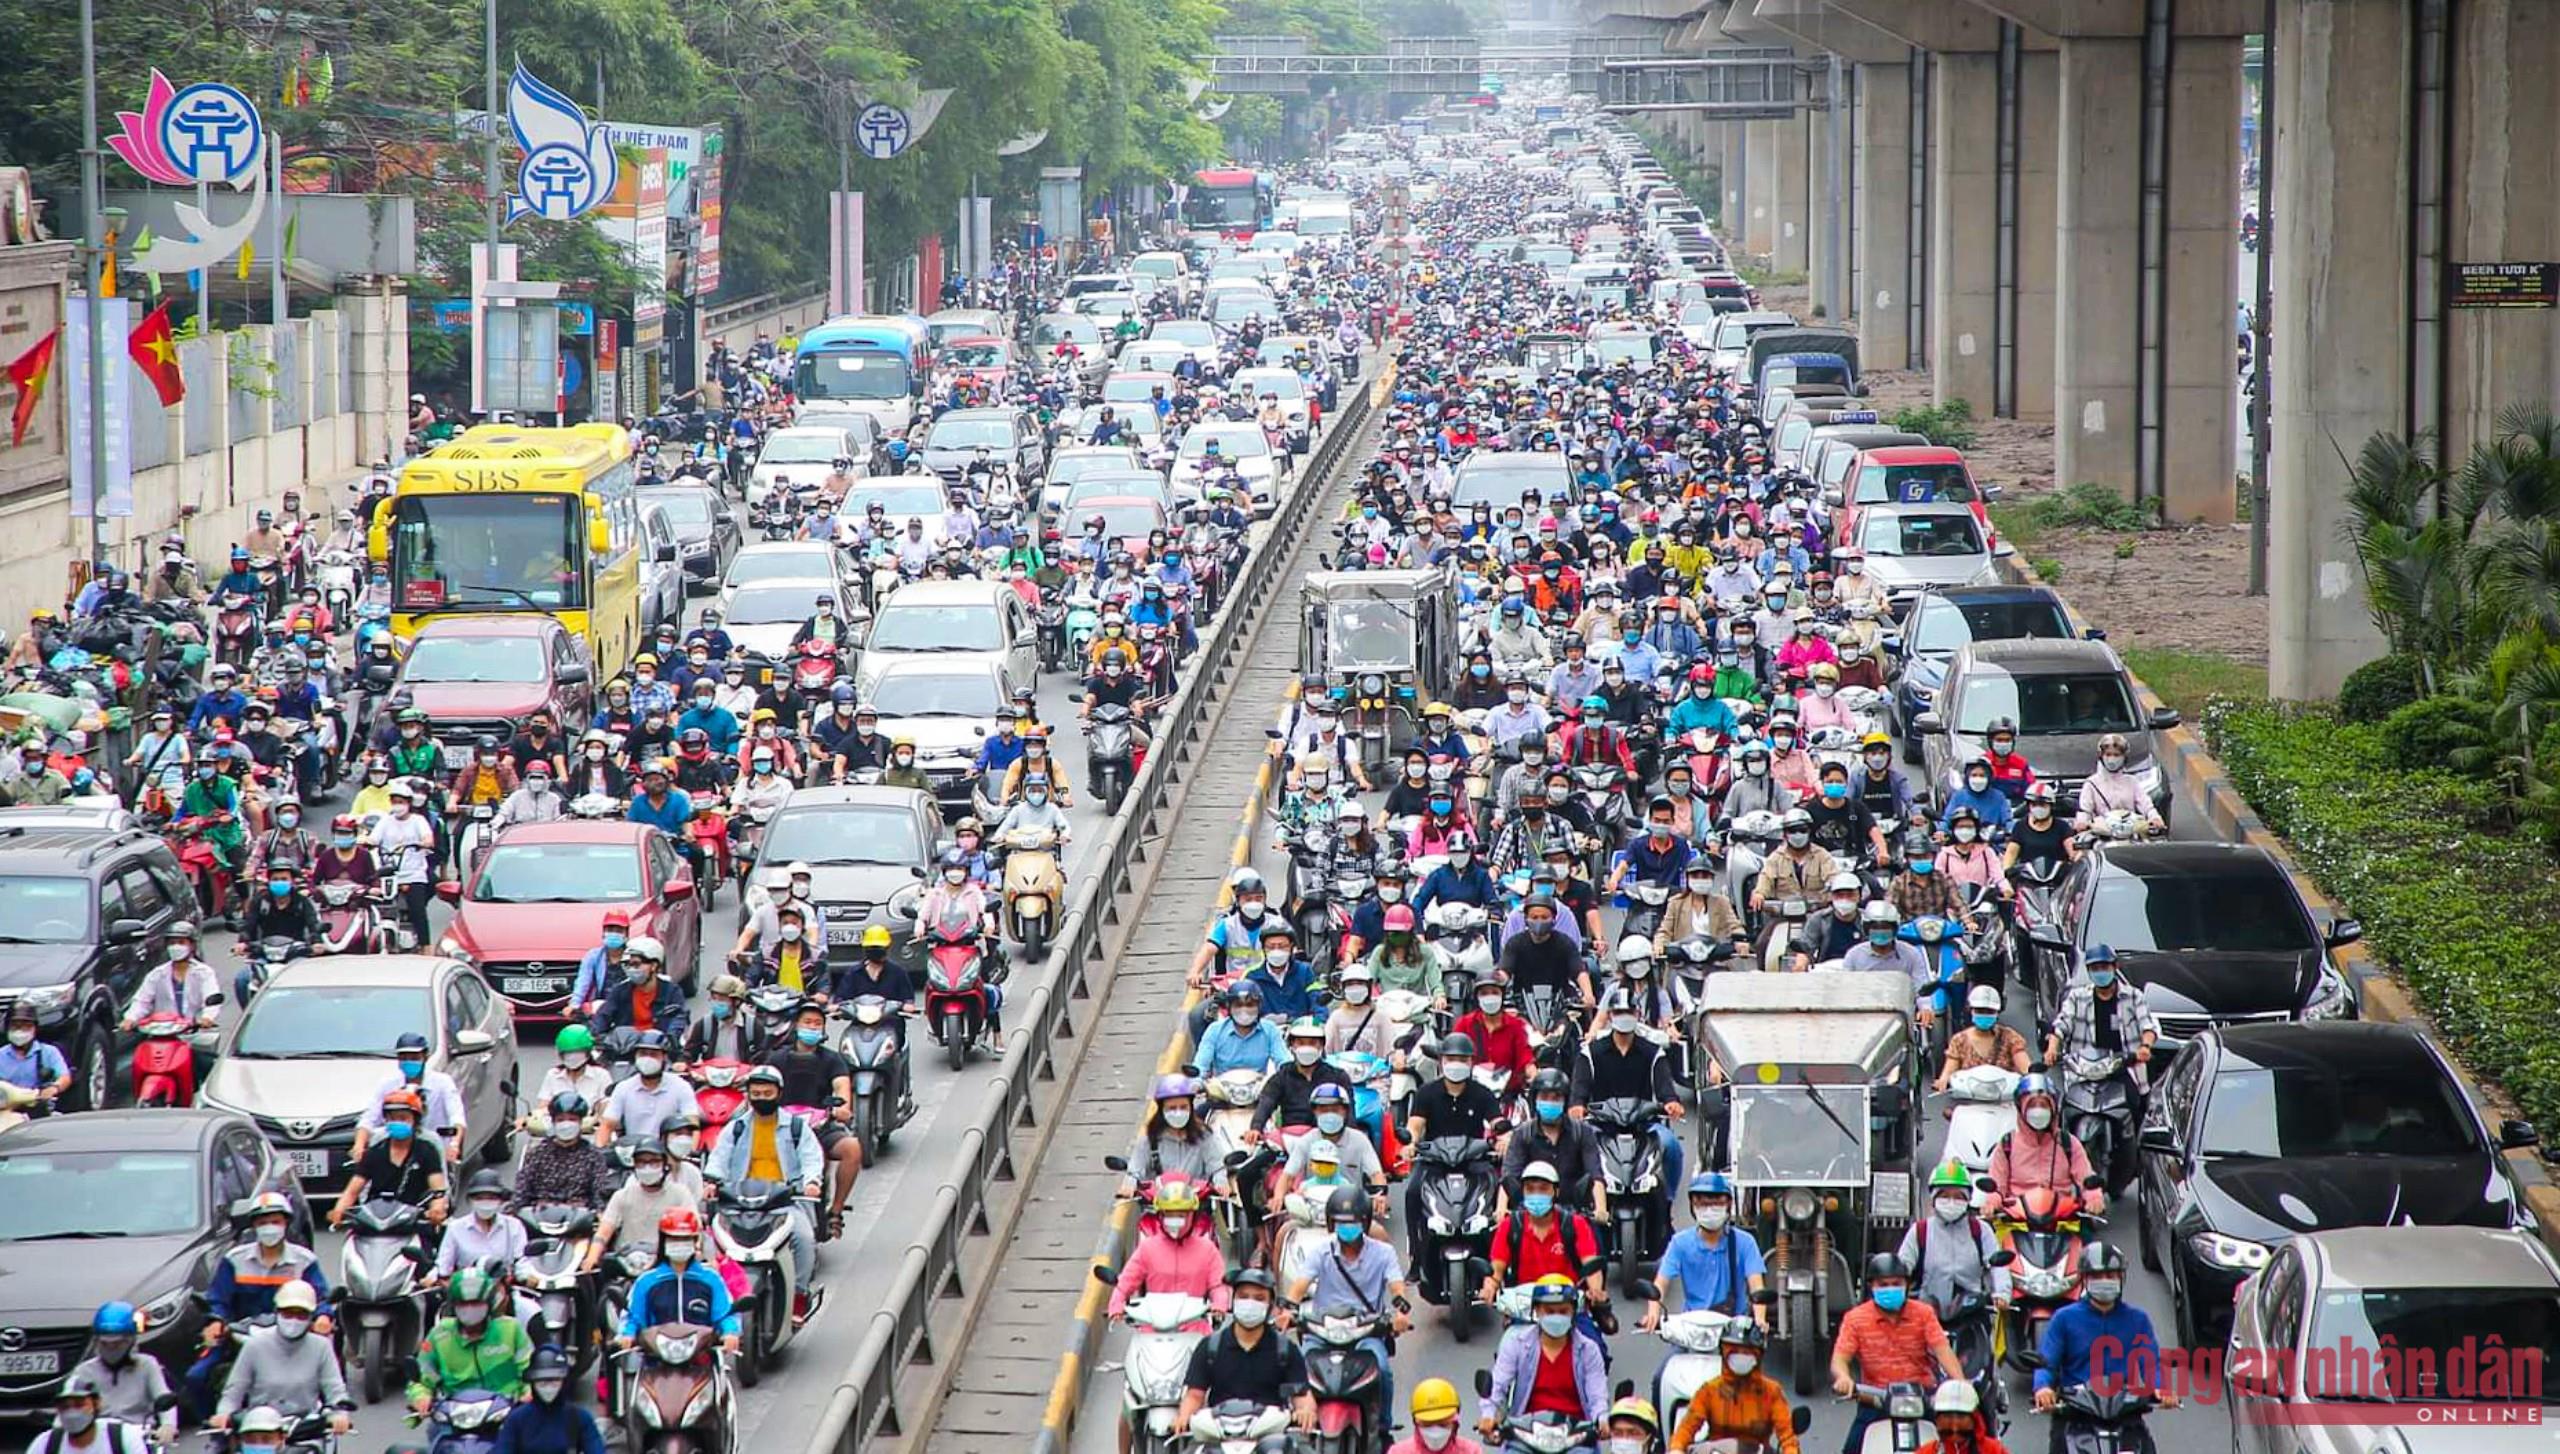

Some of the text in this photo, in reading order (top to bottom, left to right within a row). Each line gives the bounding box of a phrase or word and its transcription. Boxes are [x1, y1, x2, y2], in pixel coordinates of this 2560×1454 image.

[656, 133, 689, 150] NAM
[2462, 265, 2495, 275] BEER
[454, 469, 520, 491] SBS
